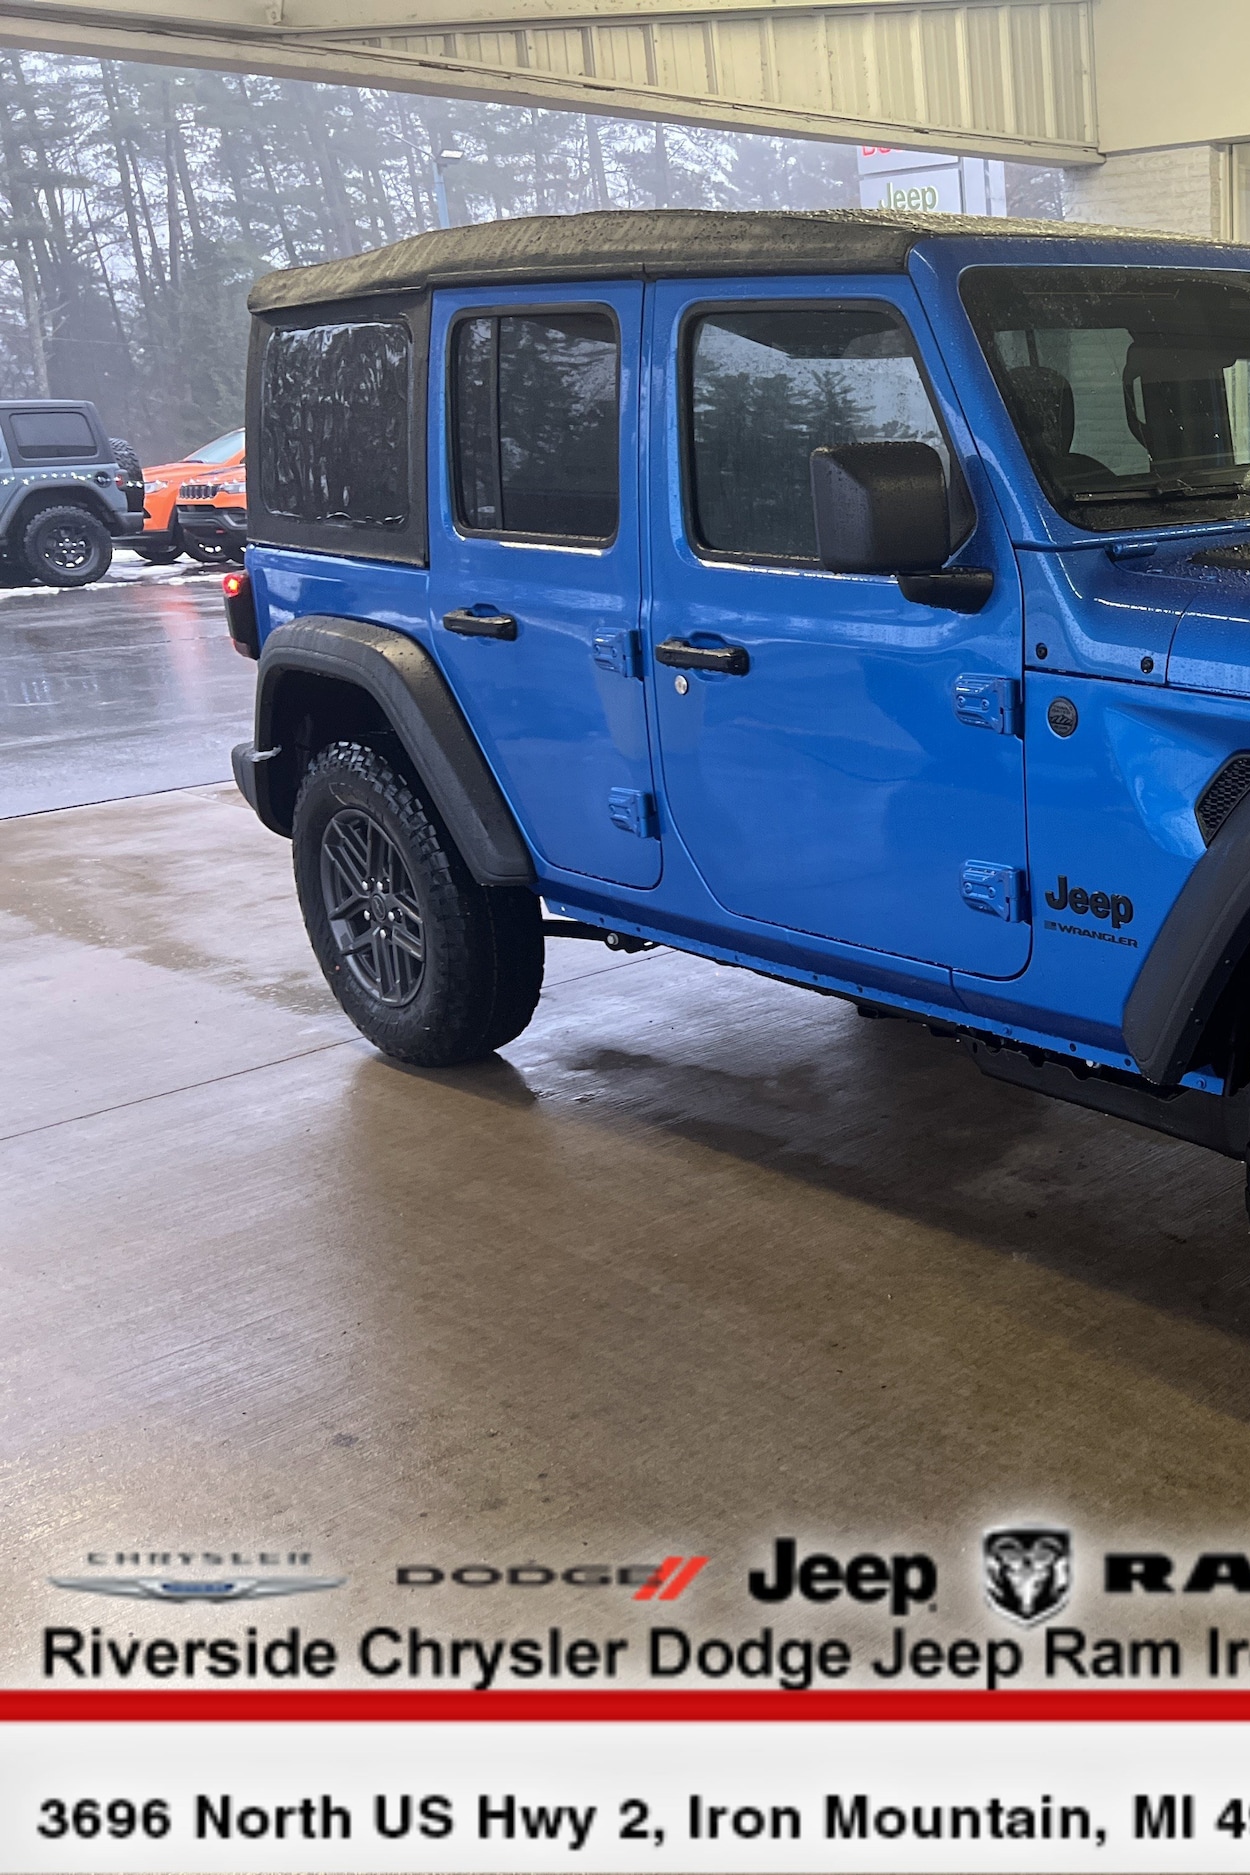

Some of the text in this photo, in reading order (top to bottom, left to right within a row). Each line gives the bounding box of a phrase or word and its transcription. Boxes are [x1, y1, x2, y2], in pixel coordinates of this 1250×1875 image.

[879, 181, 939, 210] Jeep
[1045, 875, 1134, 929] Jeep
[1058, 922, 1138, 949] WRANGLER
